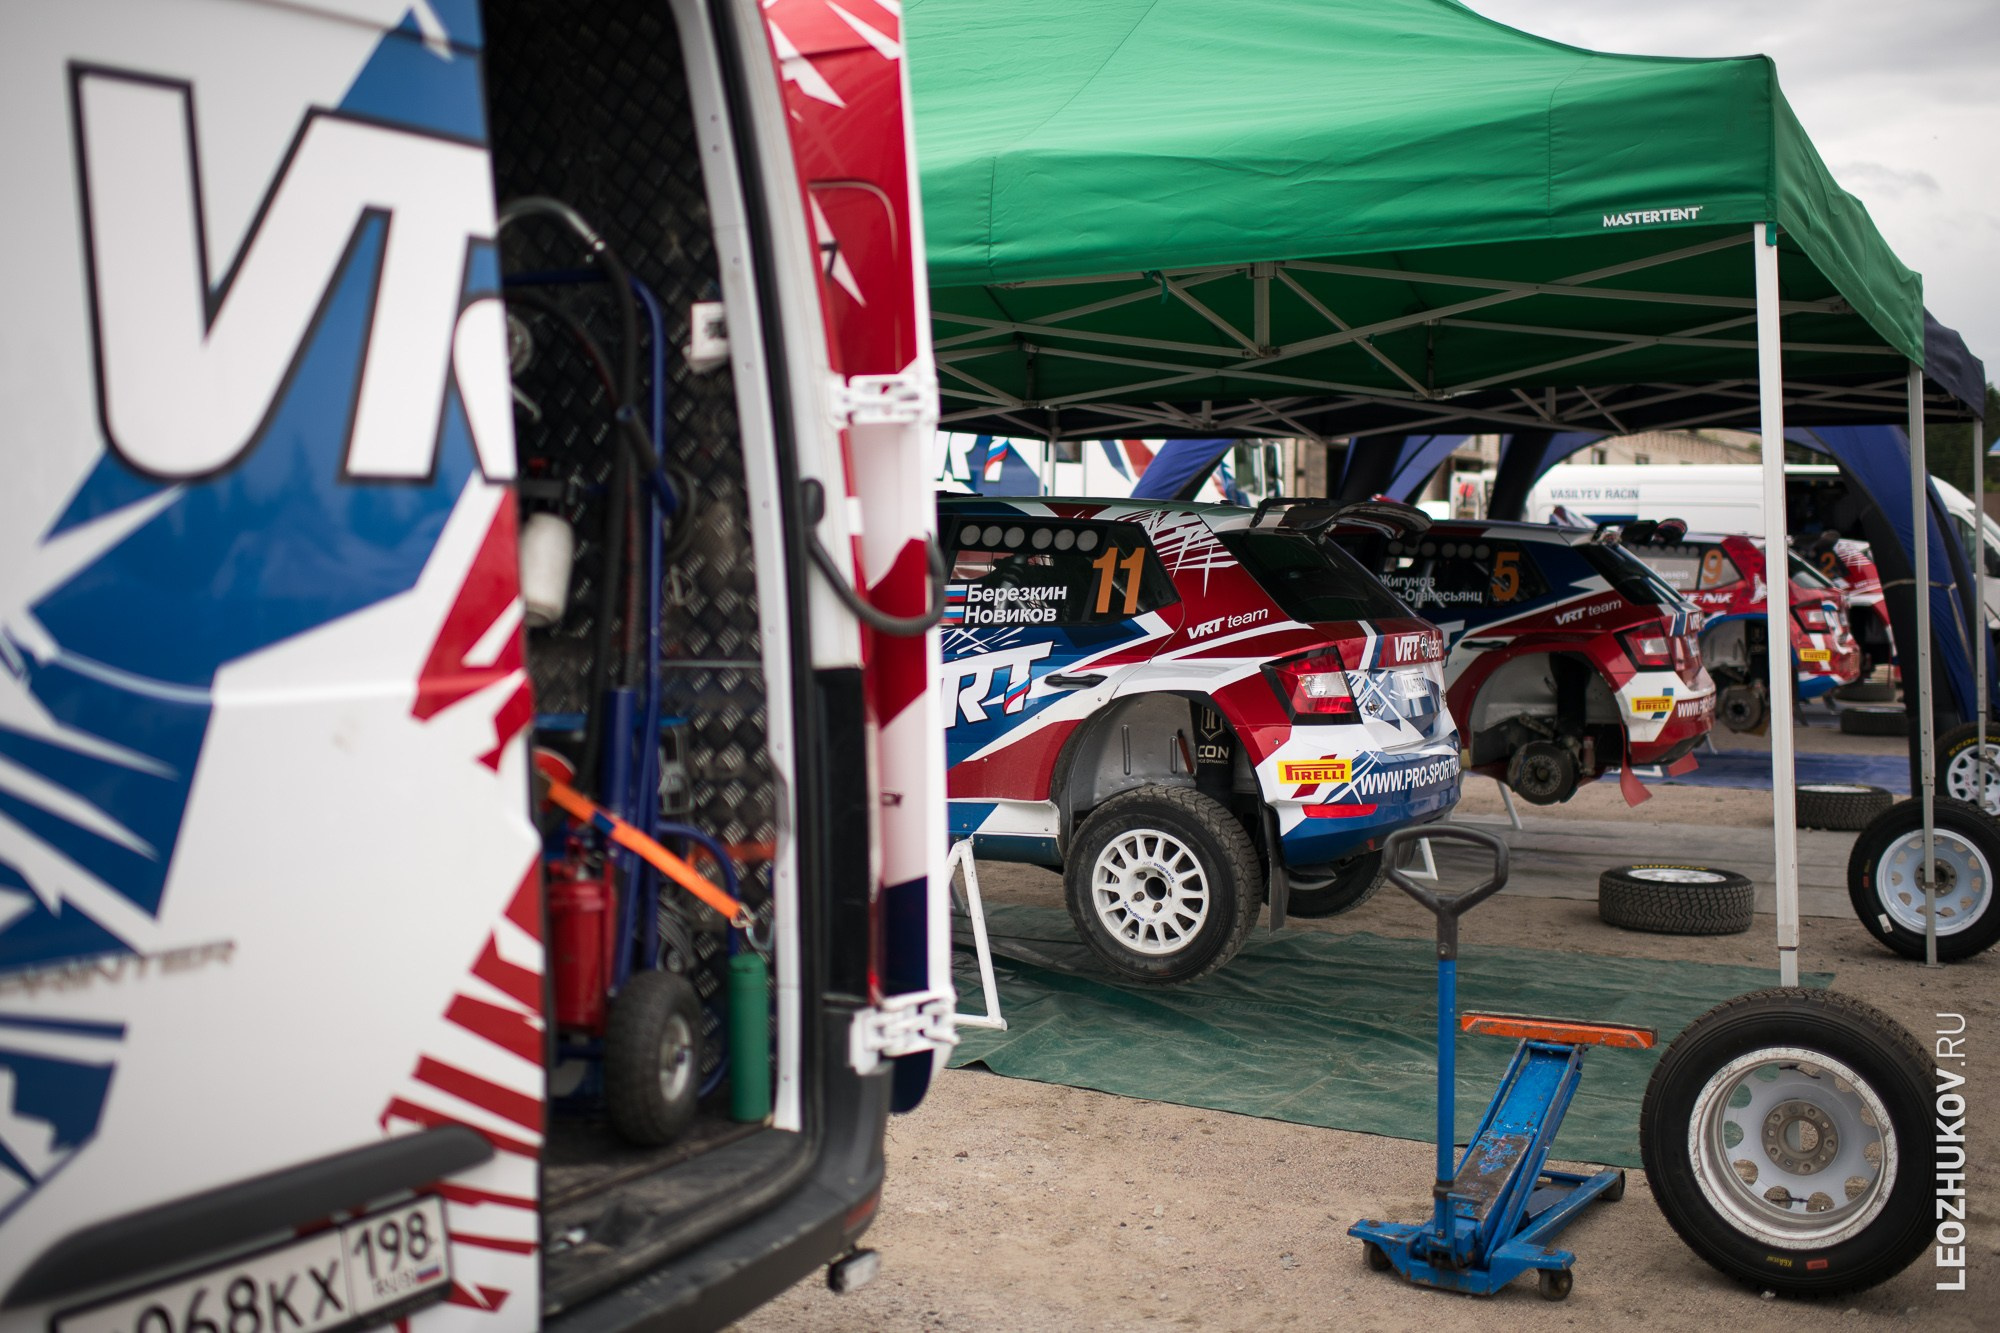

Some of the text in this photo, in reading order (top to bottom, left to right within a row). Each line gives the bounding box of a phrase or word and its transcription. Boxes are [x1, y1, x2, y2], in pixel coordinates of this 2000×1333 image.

[1603, 206, 1703, 228] MASTERTENT
[1550, 488, 1640, 500] VASILYEV RACIN
[1491, 551, 1521, 600] 5
[1702, 549, 1723, 585] 9
[1820, 552, 1836, 578] 2
[1092, 547, 1146, 615] 11
[1380, 575, 1436, 590] Жигунов
[967, 583, 1068, 606] Березкин
[1396, 588, 1483, 604] -Оганесьянц
[964, 604, 1058, 624] Новиков
[1187, 608, 1269, 639] VRT team
[1555, 600, 1622, 626] VRT team
[1394, 634, 1420, 662] VRT
[1636, 699, 1671, 711] PIRELLI
[1198, 745, 1230, 759] CON
[1285, 764, 1346, 782] PIRELLI
[353, 1211, 431, 1279] 198
